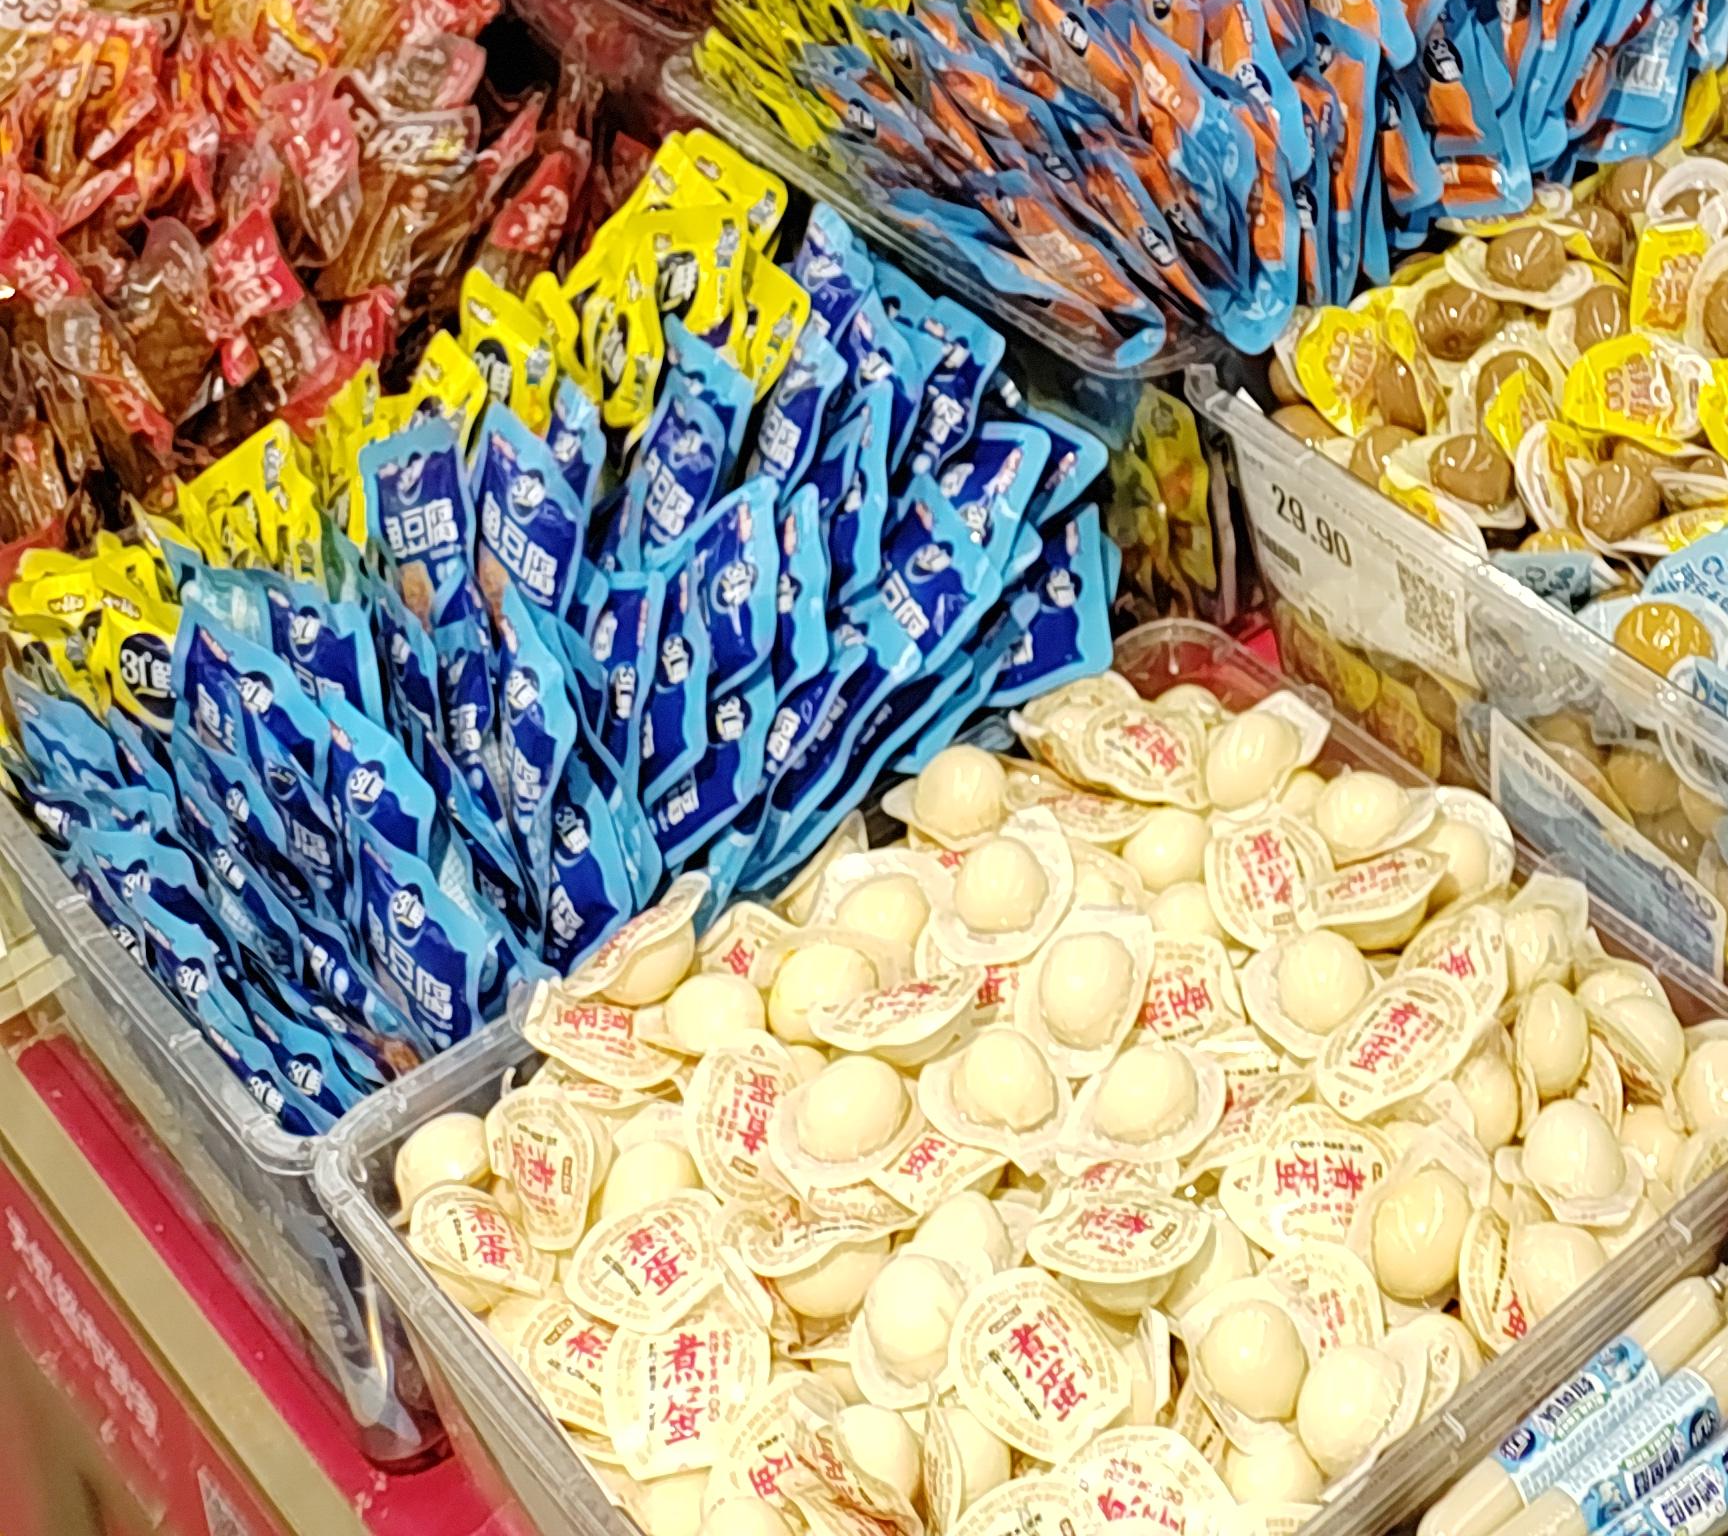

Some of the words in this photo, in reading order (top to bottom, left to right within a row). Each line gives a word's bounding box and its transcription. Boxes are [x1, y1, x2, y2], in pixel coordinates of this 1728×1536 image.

[386, 498, 460, 559] 鱼豆腐
[482, 500, 560, 601] 鱼豆腐
[1271, 483, 1352, 569] 29.90
[625, 1224, 688, 1297] 煮蛋
[661, 1332, 707, 1447] 煮蛋
[1008, 1322, 1087, 1422] 煮蛋
